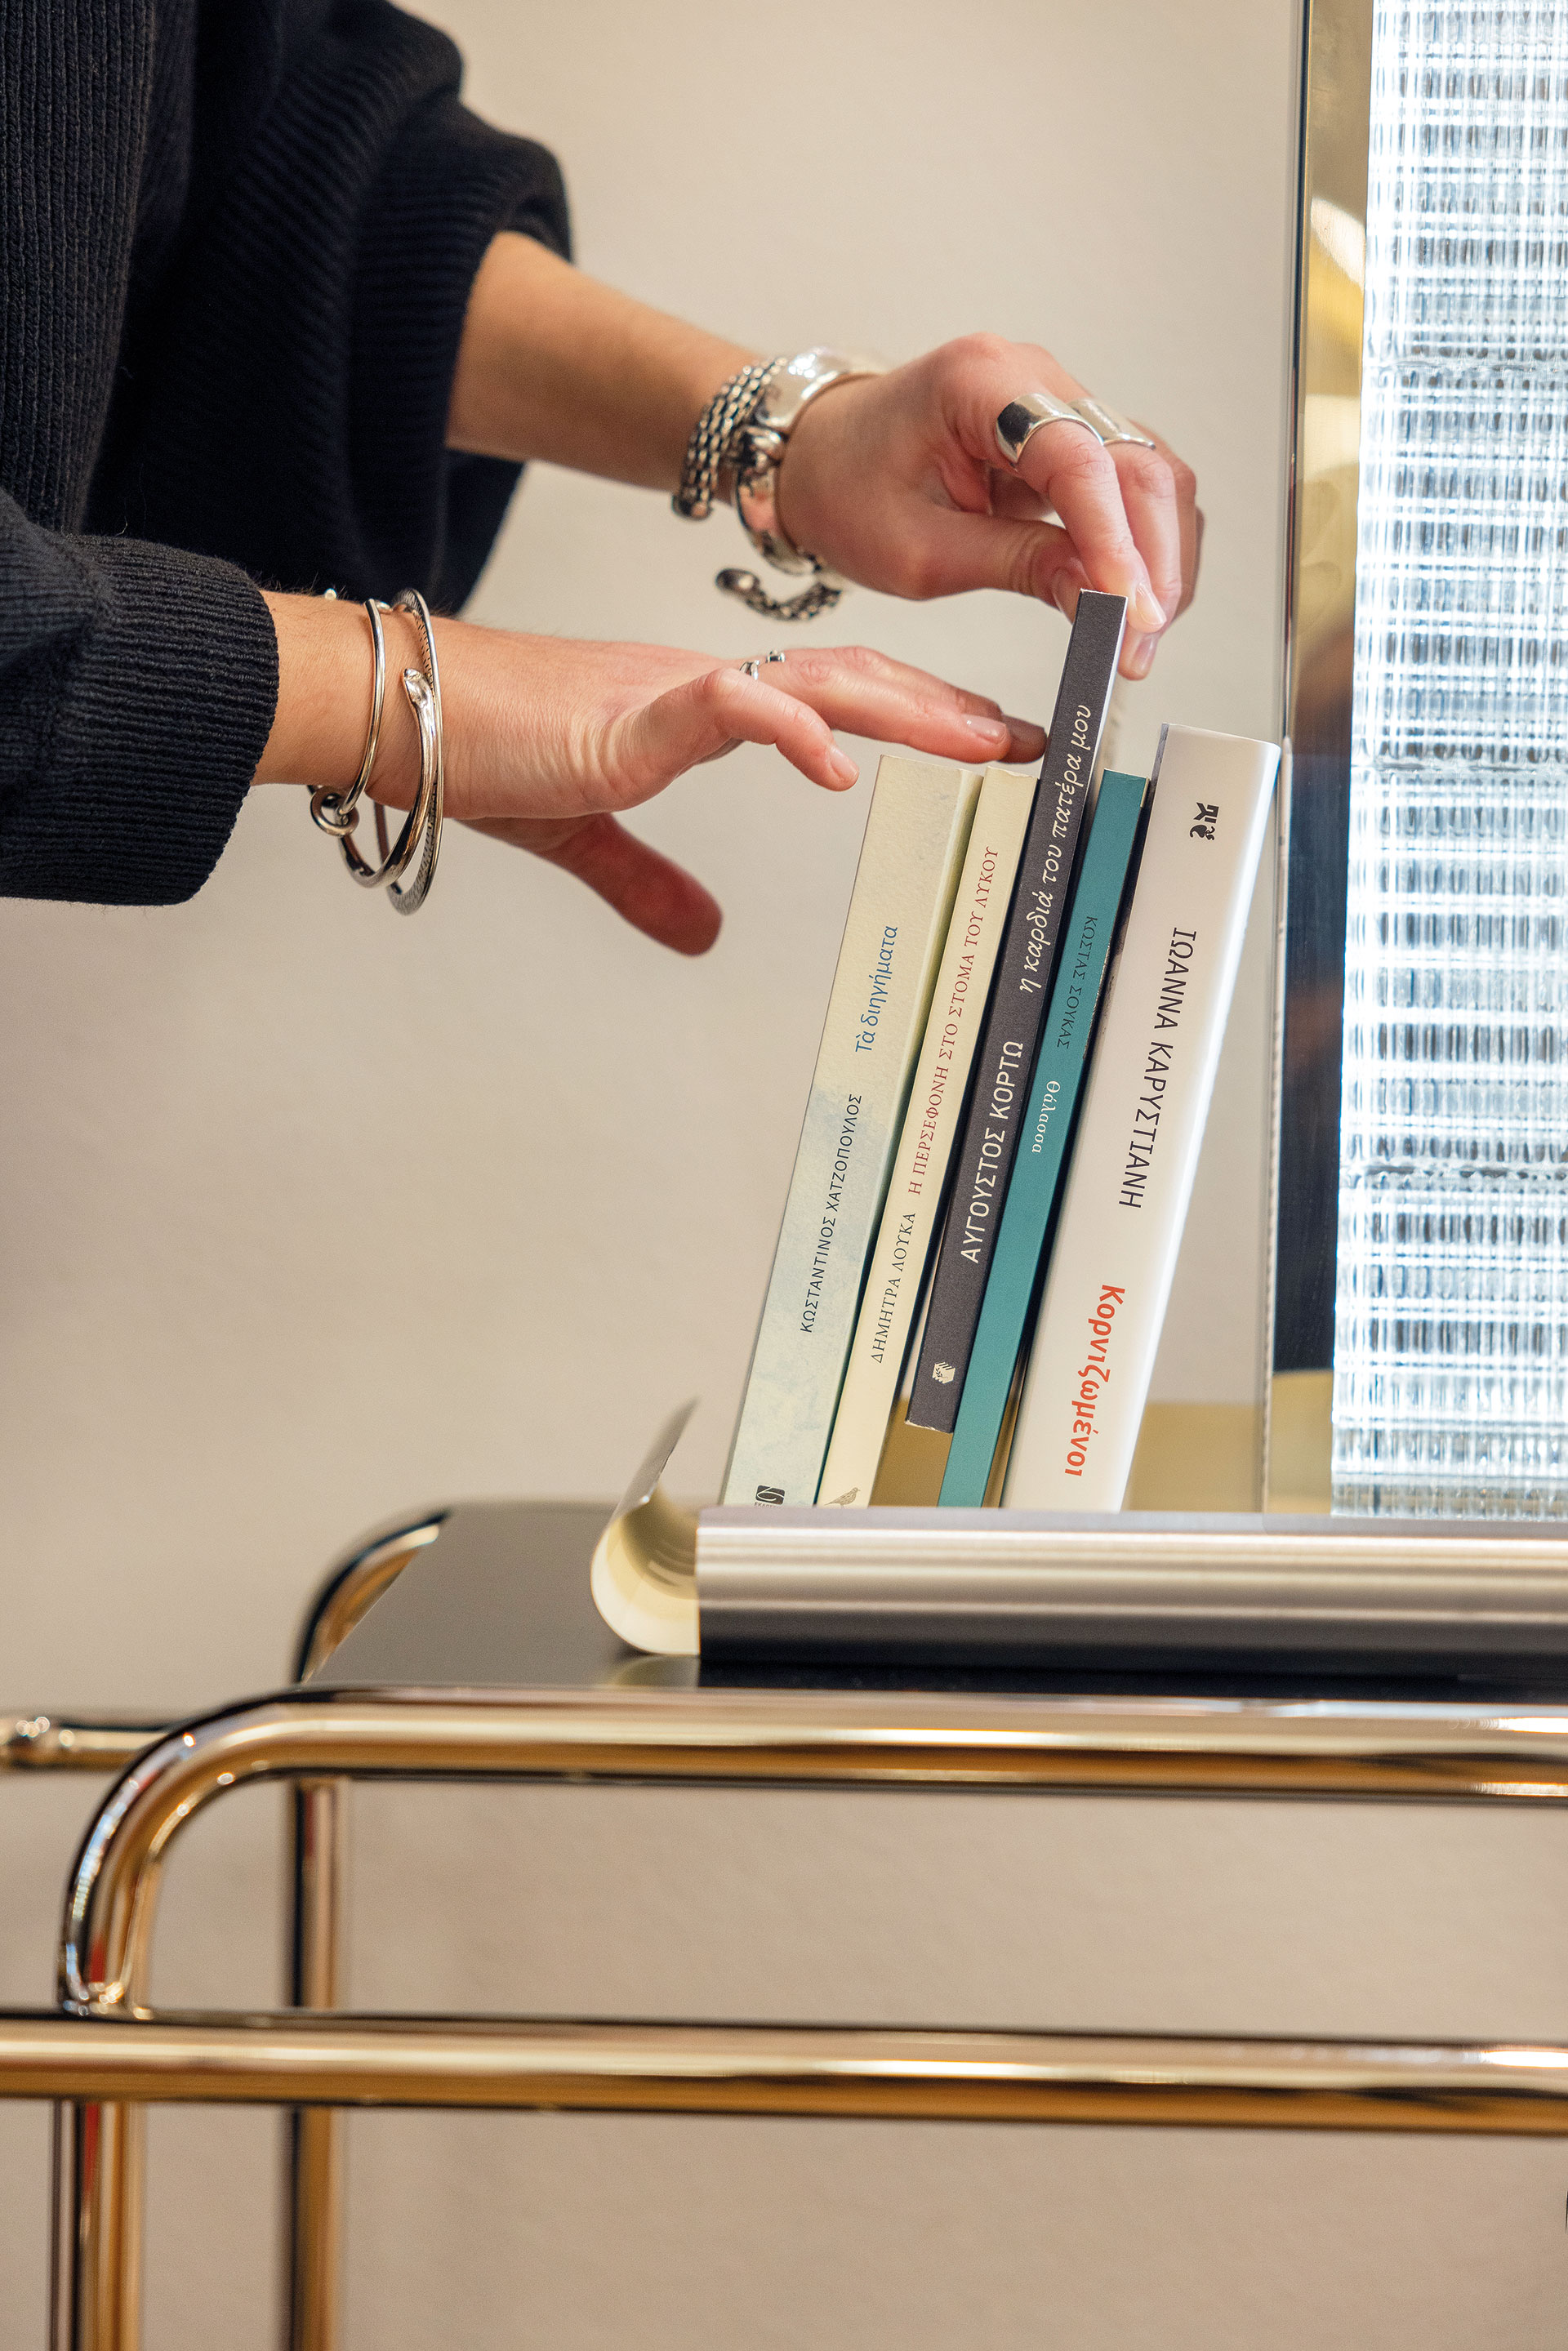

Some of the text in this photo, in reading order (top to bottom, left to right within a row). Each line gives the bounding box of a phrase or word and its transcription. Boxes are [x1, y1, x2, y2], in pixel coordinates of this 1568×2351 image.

[1020, 706, 1091, 992] η καρδιά του πατέρα μου
[861, 926, 898, 1026] διηγήματα
[908, 847, 997, 1195] Η ΠΕΡΣΕΦΟΝΗ ΣΤΟ ΣΤΟΜΑ ΤΟΥ ΛΥΚΟΥ
[1058, 916, 1098, 1049] ΚΩΣΤΑΣ ΣΟΥΚΑΣ
[1119, 928, 1196, 1208] ΙΩΑΝΝΑ ΚΑΡΥΣΤΙΑΝΗ
[800, 1094, 862, 1332] ΚΩΣΤΑΝΤΙΝΟΣ ΧΑΤΖΟΠΟΥΛΟΣ
[961, 1041, 1023, 1263] ΑΥΓΟΥΣΤΟΣ ΚΟΡΤΩ
[1032, 1081, 1060, 1152] Θάλασσα
[871, 1213, 915, 1363] ΔΗΜΗΤΡΑ ΛΟΥΚΑ
[1065, 1285, 1125, 1476] Κορνιζωμένοι
